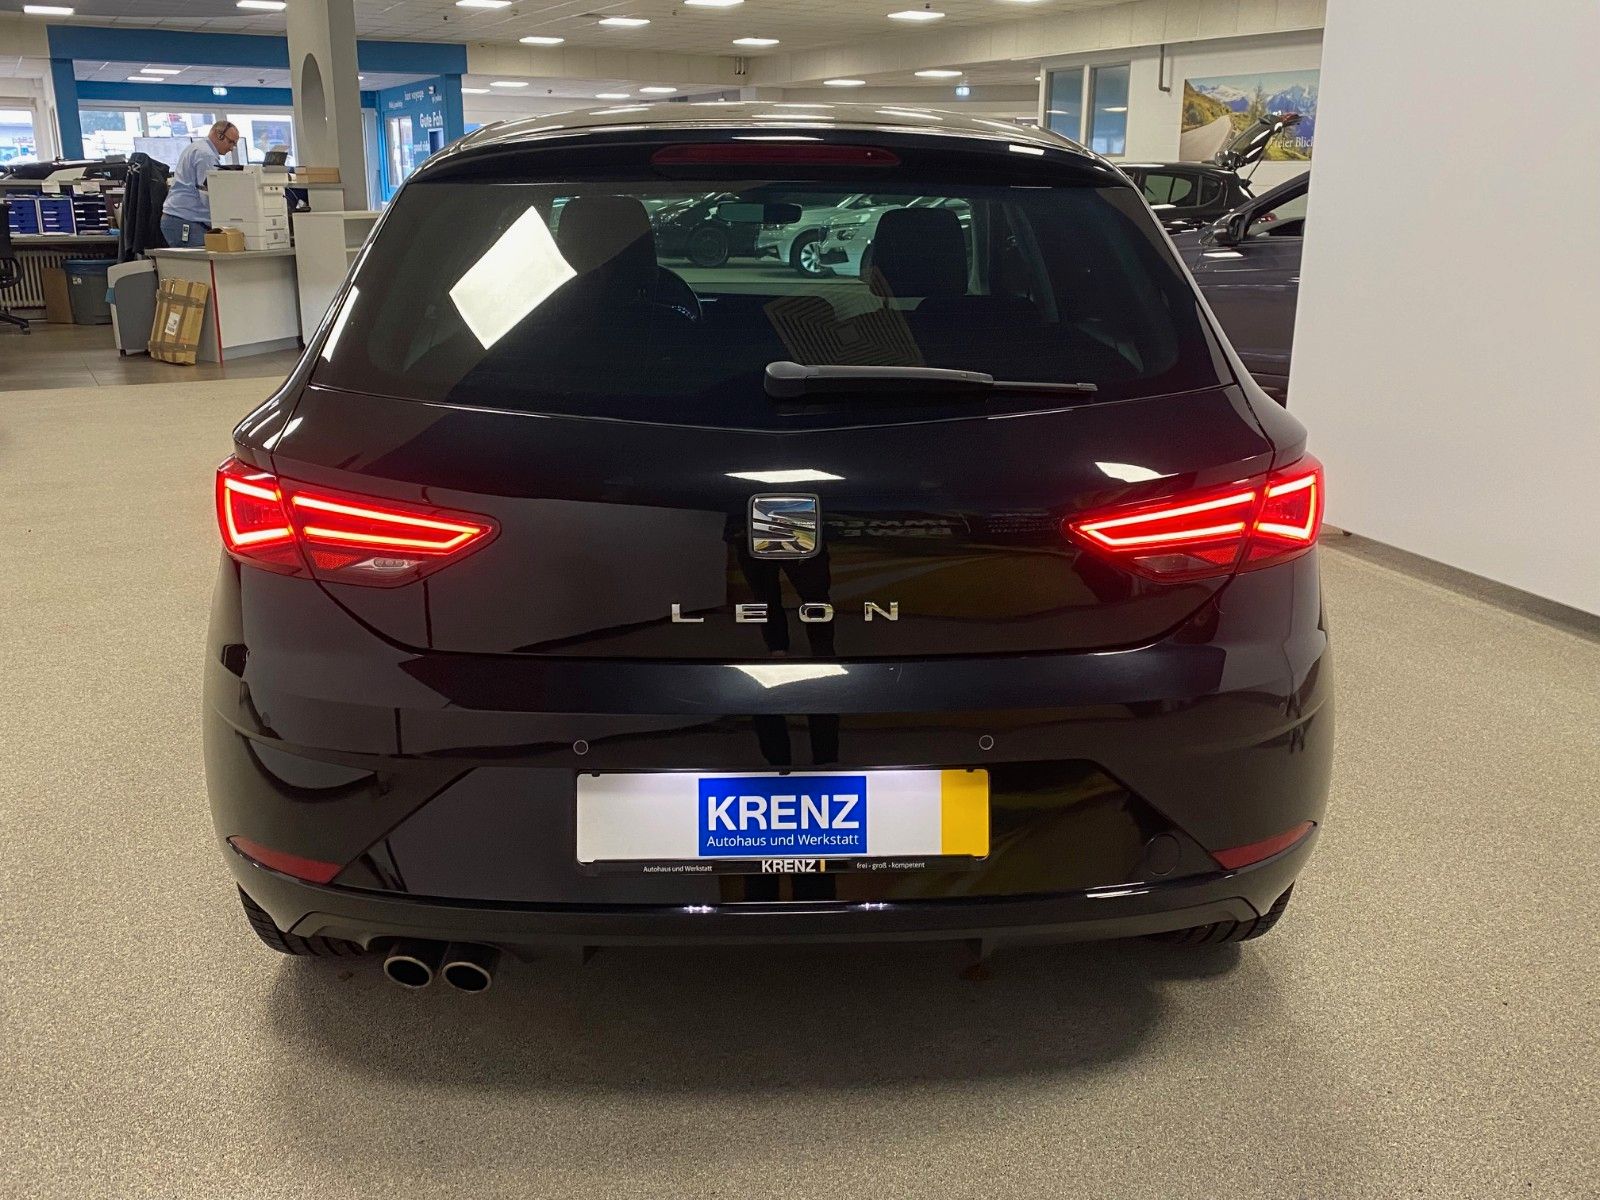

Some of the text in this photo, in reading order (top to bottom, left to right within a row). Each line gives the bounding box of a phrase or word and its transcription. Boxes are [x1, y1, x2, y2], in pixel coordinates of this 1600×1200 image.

[671, 601, 899, 623] LEON
[708, 794, 859, 831] KRENZ
[706, 834, 859, 847] Autohaus und Werkstatt
[643, 865, 713, 873] Autohaus und Werkstatt
[761, 859, 816, 873] KRENZ
[872, 862, 887, 871] groß
[891, 862, 925, 870] kompetent
